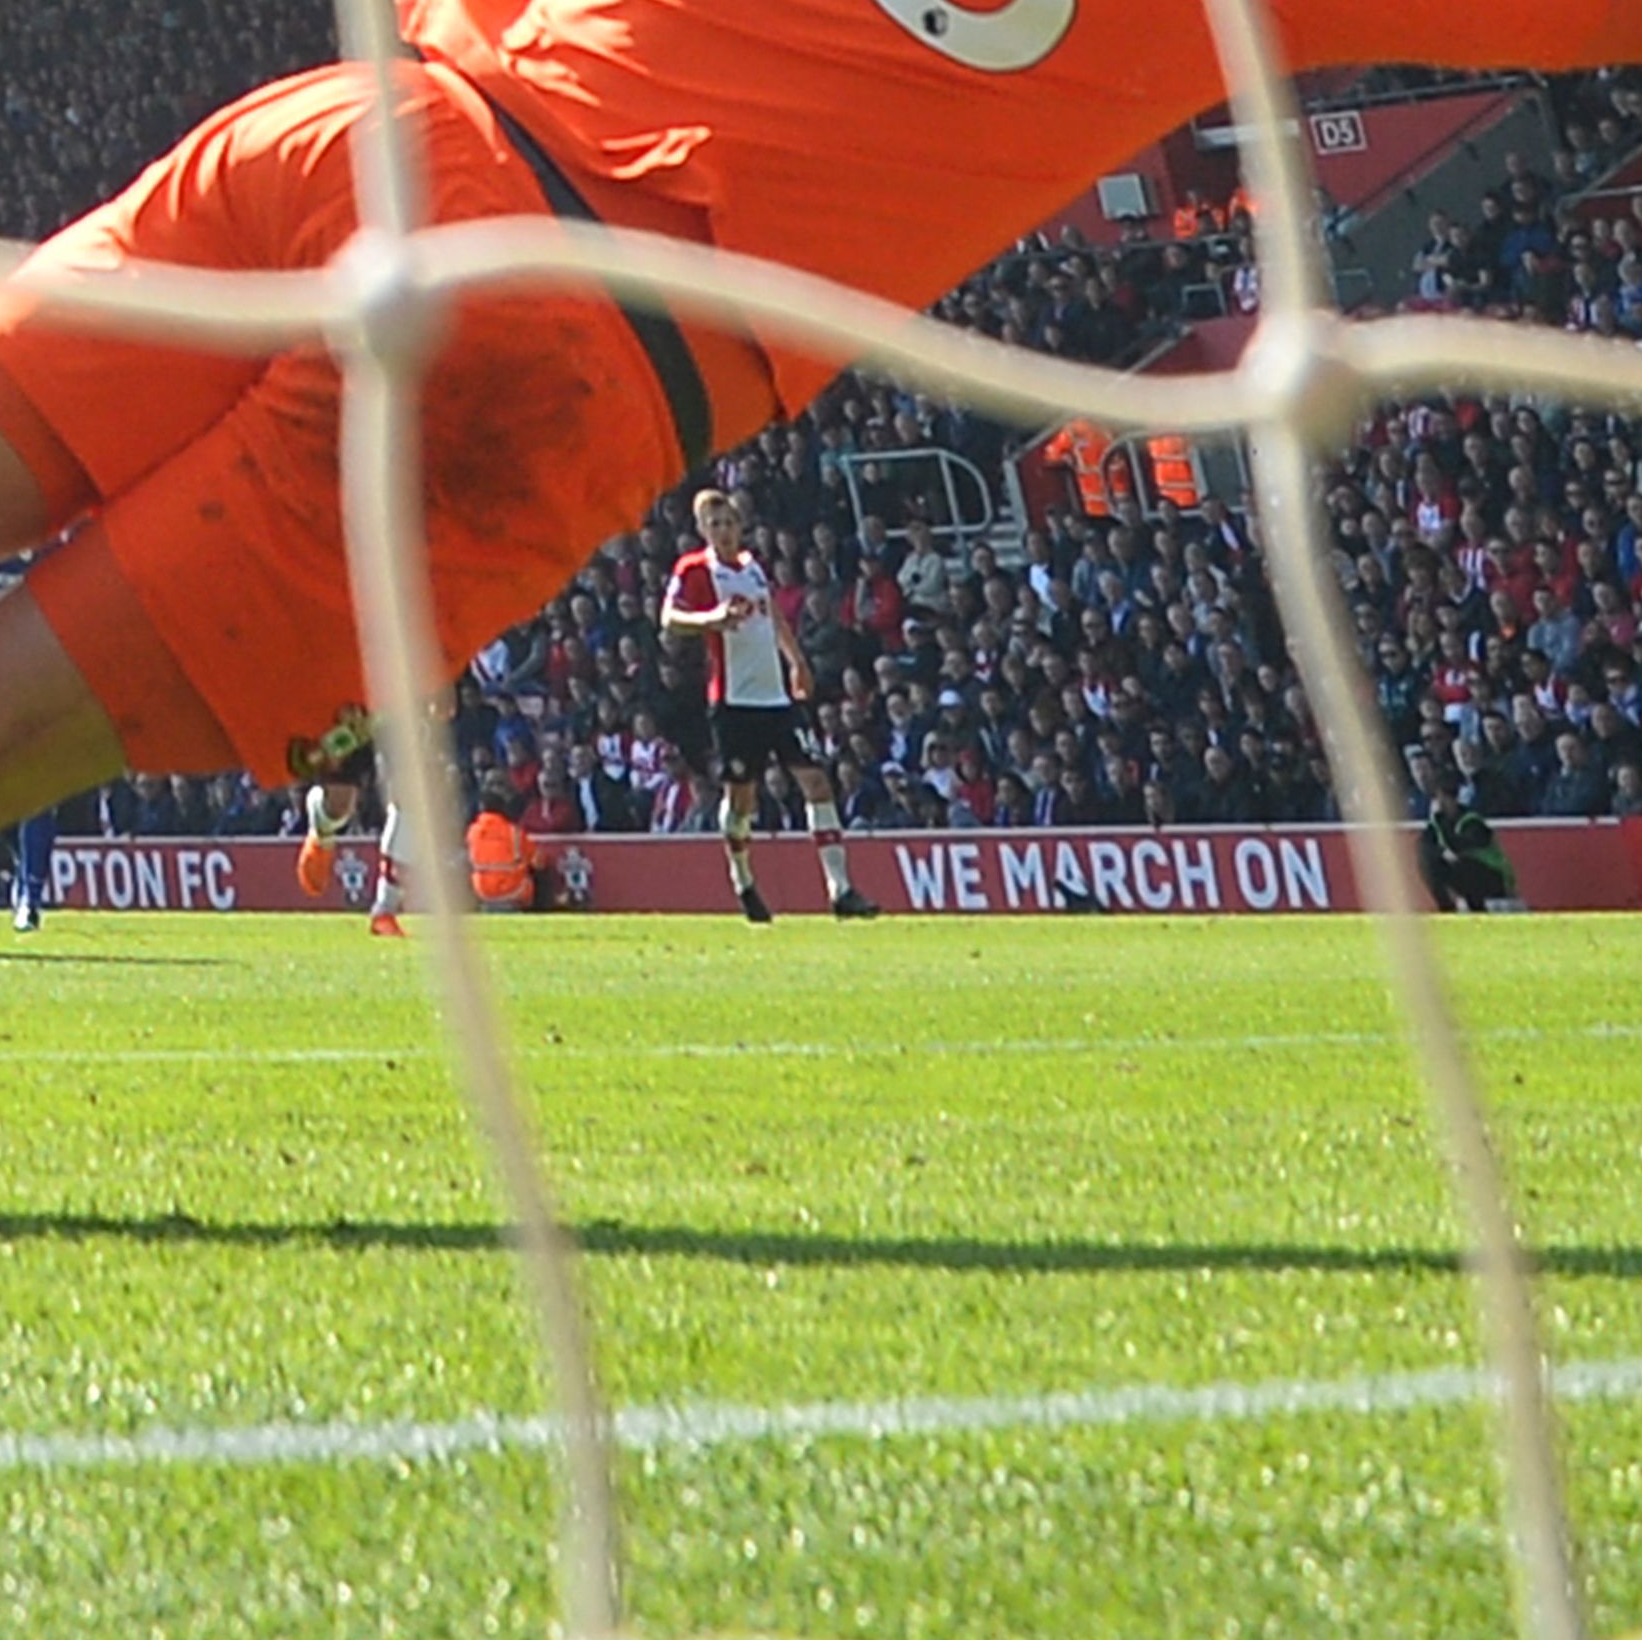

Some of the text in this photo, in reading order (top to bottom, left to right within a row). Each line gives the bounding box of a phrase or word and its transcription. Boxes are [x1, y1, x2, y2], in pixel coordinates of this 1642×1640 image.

[1320, 118, 1355, 146] D5
[40, 848, 236, 910] PTON FC
[895, 837, 1330, 910] WE MARCH ON
